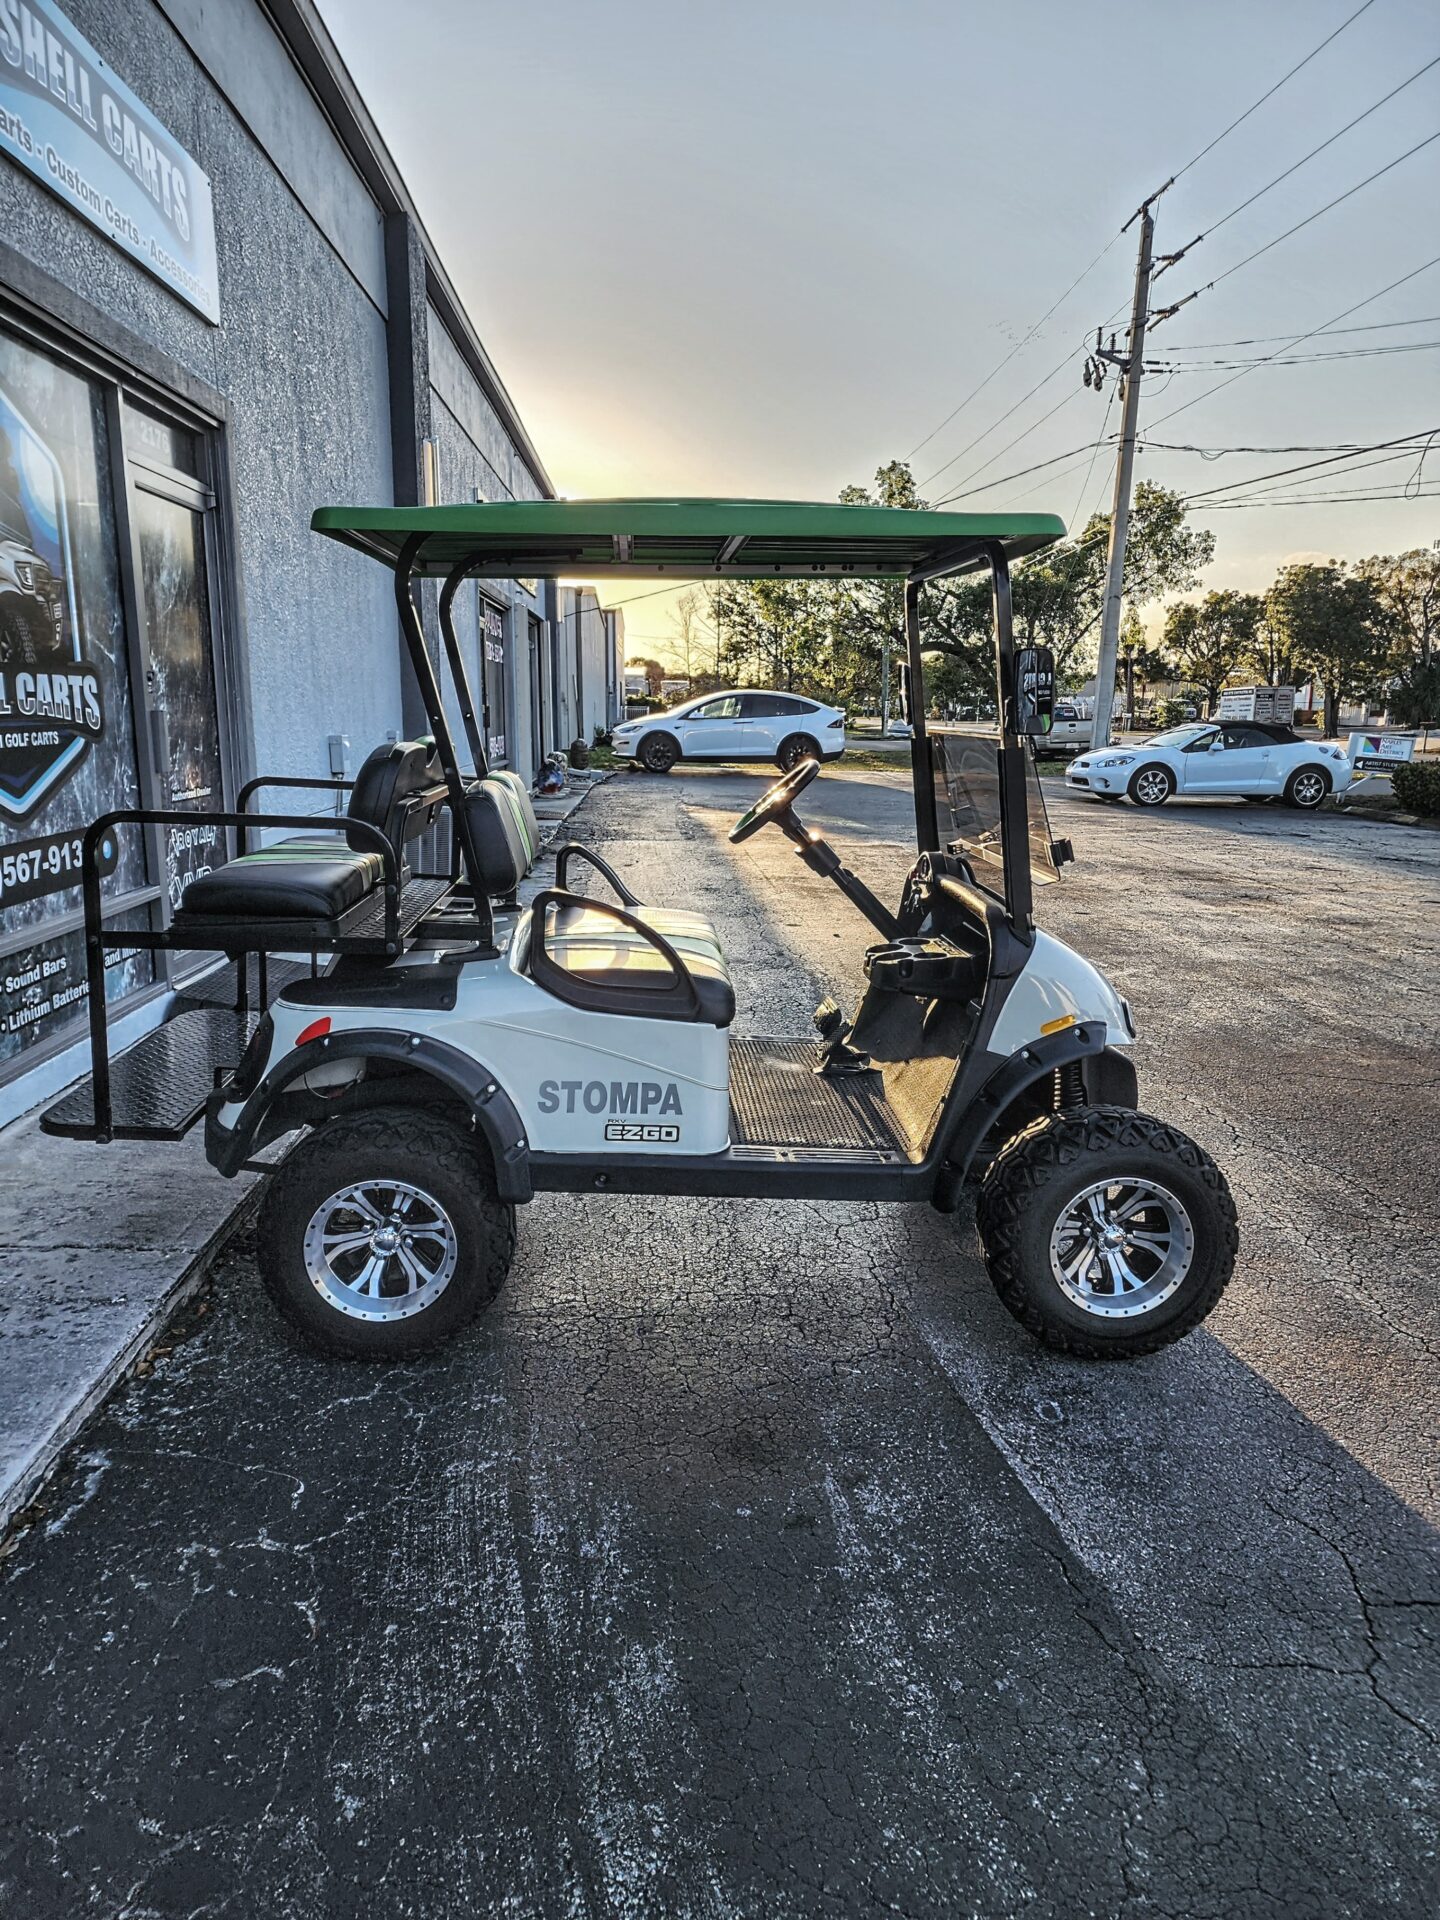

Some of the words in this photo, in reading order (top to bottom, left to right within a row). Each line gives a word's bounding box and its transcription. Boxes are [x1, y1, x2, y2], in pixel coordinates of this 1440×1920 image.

[102, 93, 191, 242] CARTS
[47, 147, 102, 213] Custom
[103, 198, 140, 246] Carts
[15, 672, 100, 730] CARTS
[5, 732, 29, 748] GOLF
[31, 731, 59, 746] CARTS
[5, 965, 40, 993] Sound
[42, 957, 67, 978] Bars
[9, 1000, 51, 1031] Lithium
[537, 1080, 683, 1115] STOMPA
